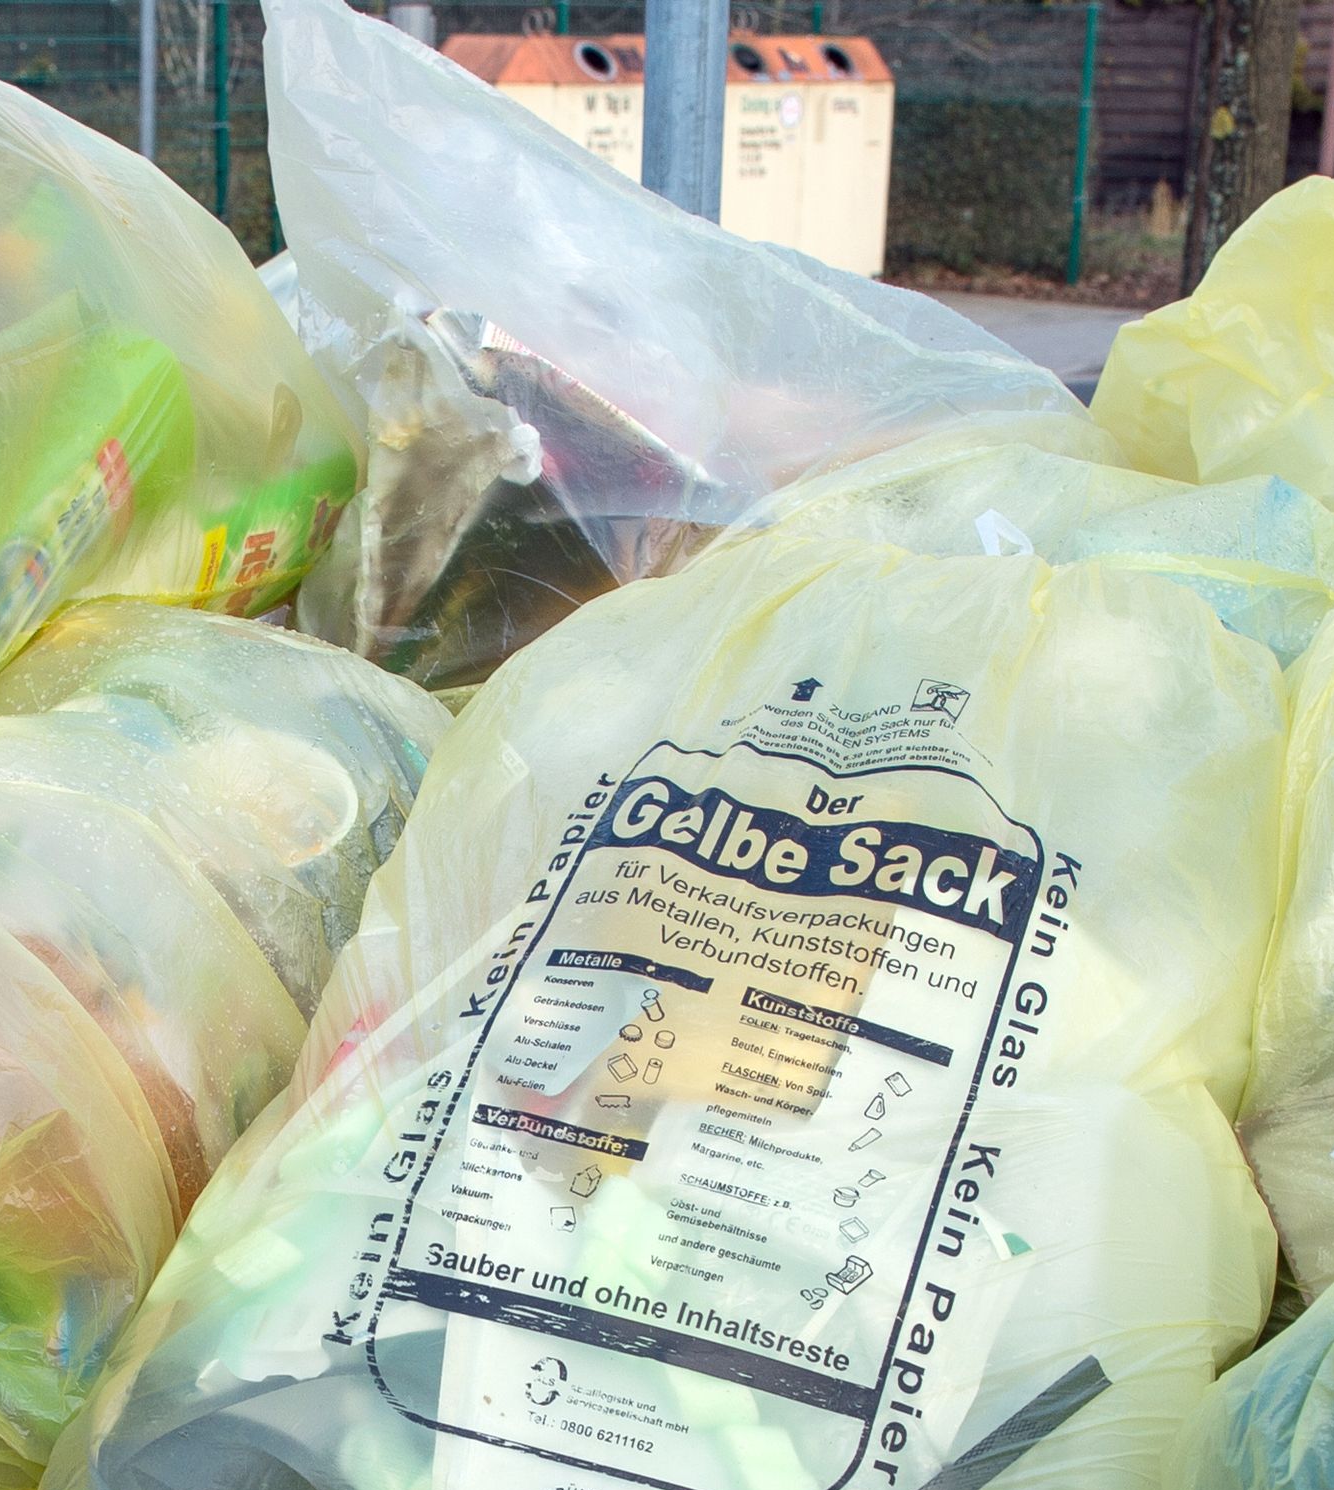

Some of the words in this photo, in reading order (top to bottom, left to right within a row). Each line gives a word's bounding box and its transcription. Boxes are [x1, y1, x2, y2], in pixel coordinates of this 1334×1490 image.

[829, 704, 901, 722] ZUGBAND
[880, 718, 910, 731] Sack
[913, 718, 936, 728] nur
[781, 718, 803, 729] des
[807, 721, 862, 749] DUALEN
[864, 728, 931, 746] SYSTEMS
[805, 784, 864, 815] Der
[611, 781, 809, 885] Gelbe
[828, 826, 1019, 926] Sack
[458, 919, 537, 1020] Kein
[525, 770, 619, 905] Papier
[615, 860, 652, 882] für
[659, 862, 958, 960] Verkaufsverpackungen
[1030, 847, 1085, 961] Kein
[575, 888, 621, 907] aus
[626, 885, 741, 944] Metallen,
[750, 923, 919, 983] Kunststoffen
[927, 970, 979, 1000] und
[557, 952, 624, 969] Metalle
[658, 924, 865, 997] Verbundstoffen.
[544, 975, 595, 988] Konserven
[533, 995, 605, 1013] Getränkedosen
[747, 990, 861, 1035] Kunststoffe
[523, 1015, 581, 1033] Verschlüsse
[991, 979, 1049, 1091] Glas
[730, 1036, 765, 1057] Beutel,
[783, 1026, 853, 1056] Tragetaschen,
[504, 1054, 559, 1071] Alu-Deckel
[720, 1061, 782, 1088] FLASCHEN:
[785, 1079, 804, 1092] Von
[705, 1103, 772, 1127] pflegemitteln
[714, 1082, 752, 1099] Wasch-
[754, 1093, 774, 1106] und
[775, 1098, 814, 1117] Körper-
[746, 1158, 765, 1170] etc.
[748, 1135, 823, 1165] Milchprodukte,
[450, 1184, 494, 1201] Vakuum-
[933, 1141, 1002, 1261] Kein
[666, 1209, 768, 1244] Gemüsebehältnisse
[700, 1206, 722, 1218] und
[658, 1232, 678, 1244] und
[680, 1236, 716, 1254] andere
[717, 1244, 782, 1272] geschäumte
[425, 1242, 525, 1284] Sauber
[531, 1271, 589, 1299] und
[594, 1285, 668, 1319] ohne
[676, 1302, 851, 1373] Inhaltsreste
[872, 1280, 958, 1489] Papier
[636, 1400, 657, 1413] und
[559, 1419, 594, 1438] 0800
[596, 1428, 655, 1453] 6211162
[664, 1420, 690, 1435] mbH
